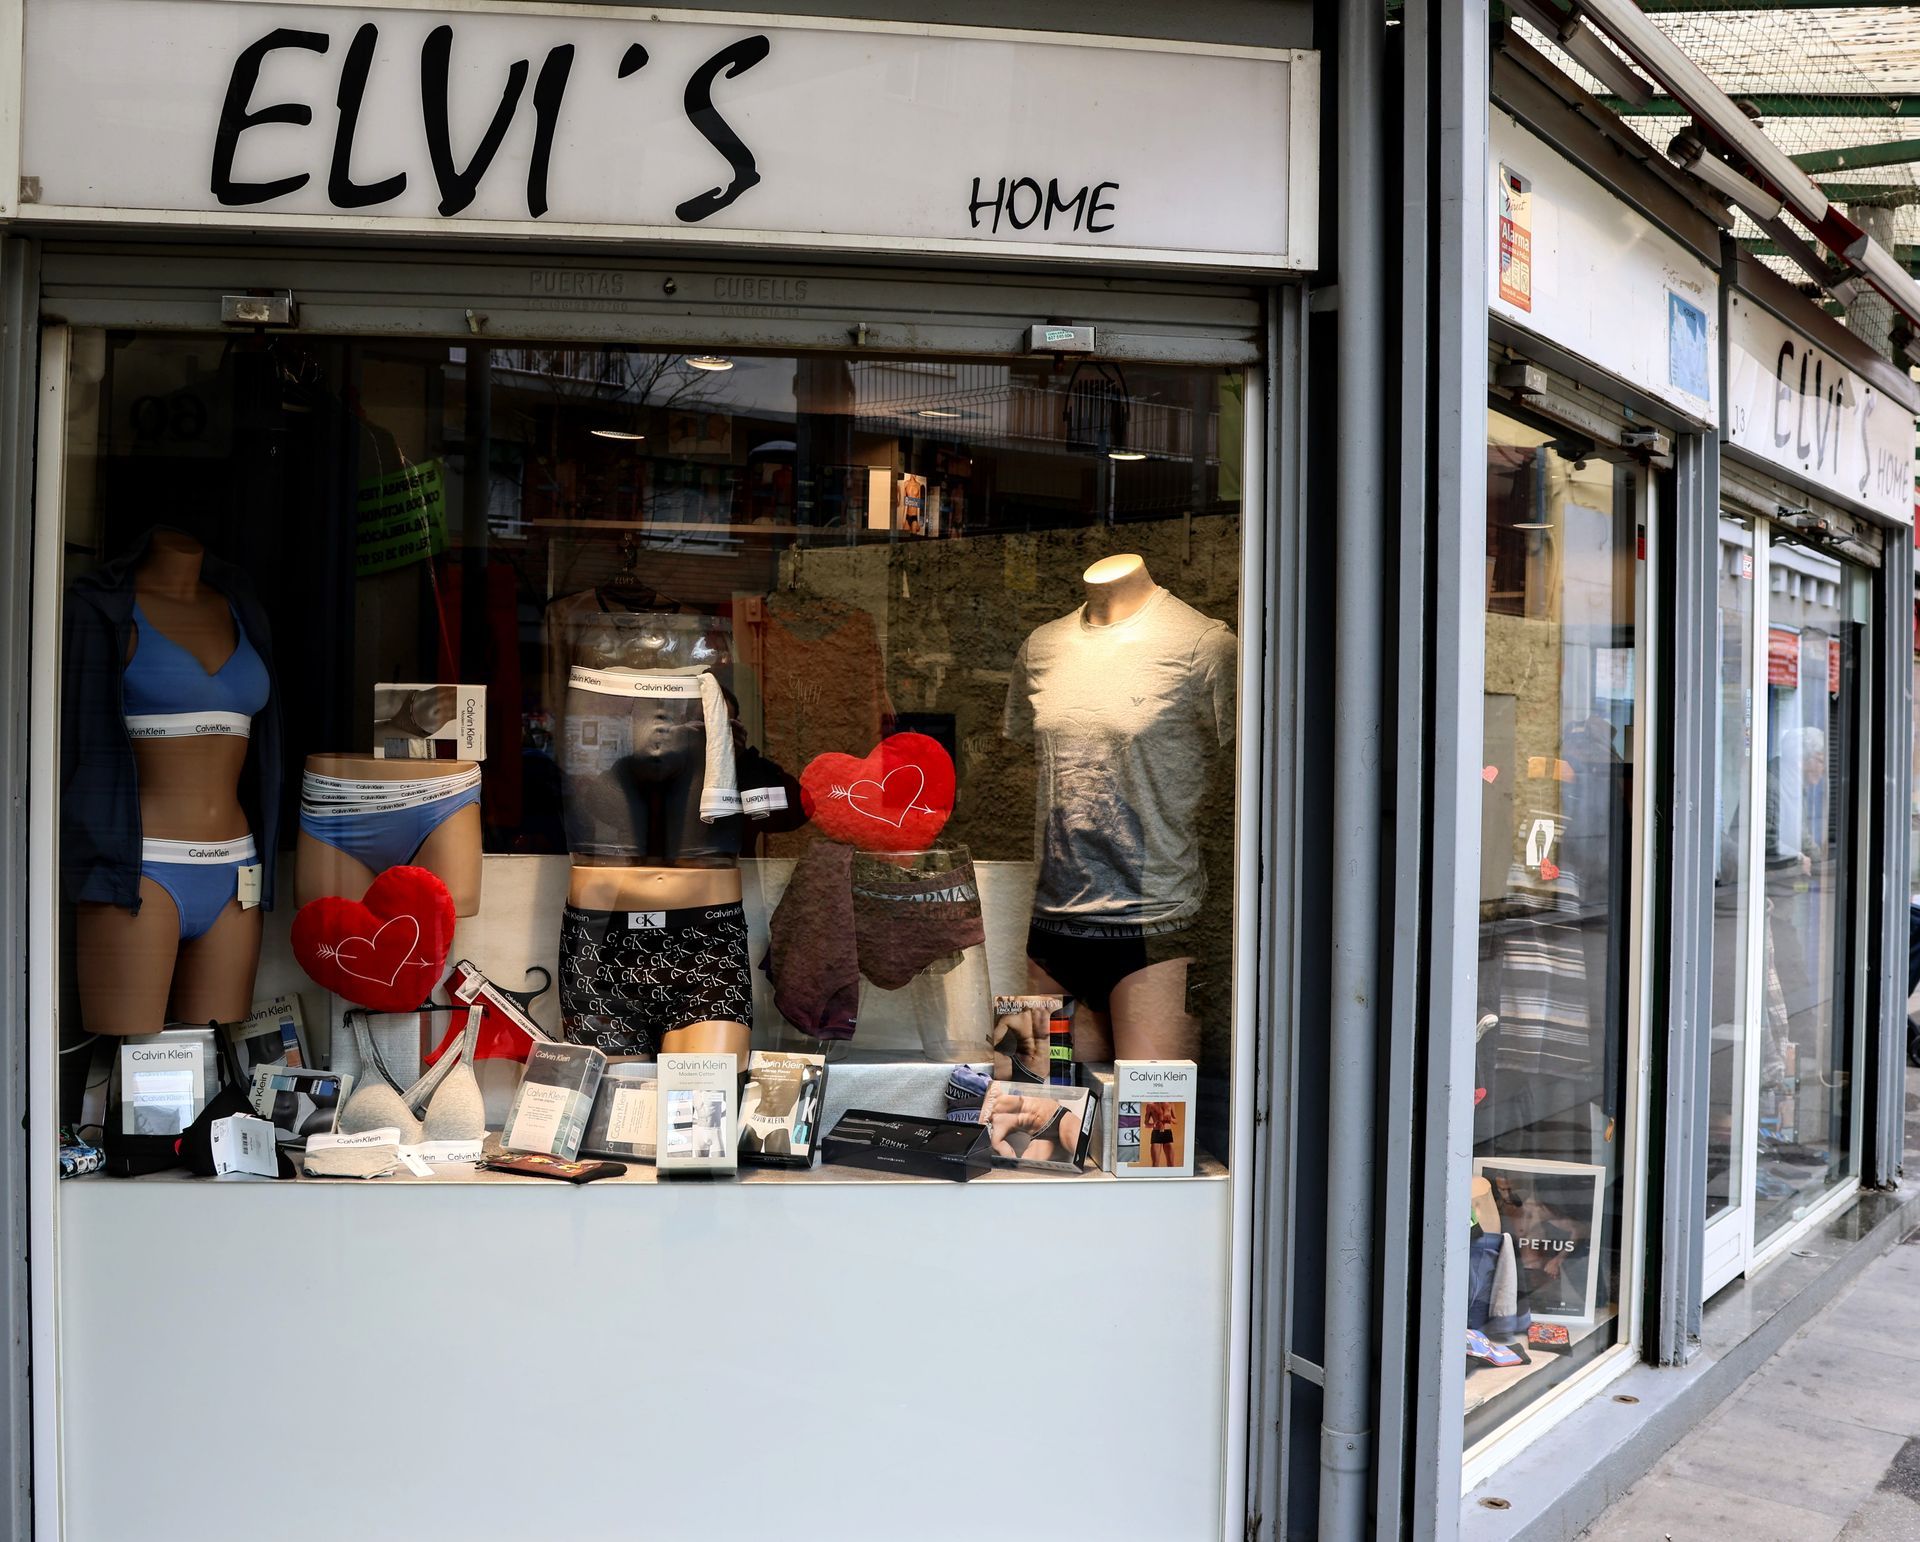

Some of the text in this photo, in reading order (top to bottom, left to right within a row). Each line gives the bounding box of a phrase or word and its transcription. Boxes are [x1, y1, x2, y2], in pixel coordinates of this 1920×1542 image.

[211, 22, 769, 222] ELVI'S
[969, 175, 1120, 234] HOME
[1501, 221, 1530, 251] Alarma
[529, 271, 809, 301] PUERTAS CUBELLS
[1734, 403, 1746, 433] 13
[1876, 447, 1911, 504] HOME
[634, 682, 684, 693] Calvin Klein
[466, 698, 476, 749] Calvin Klein
[570, 912, 590, 923] Klein
[705, 910, 733, 920] Calvin
[268, 1004, 293, 1018] Klein
[131, 1050, 193, 1061] Calvin Klein
[535, 1050, 556, 1062] Calvin
[667, 1059, 728, 1071] Calvin Klein
[782, 1060, 805, 1070] Klein
[1129, 1071, 1188, 1082] Calvin Klein
[526, 1087, 549, 1099] Calvin
[1518, 1237, 1575, 1253] PETUS
